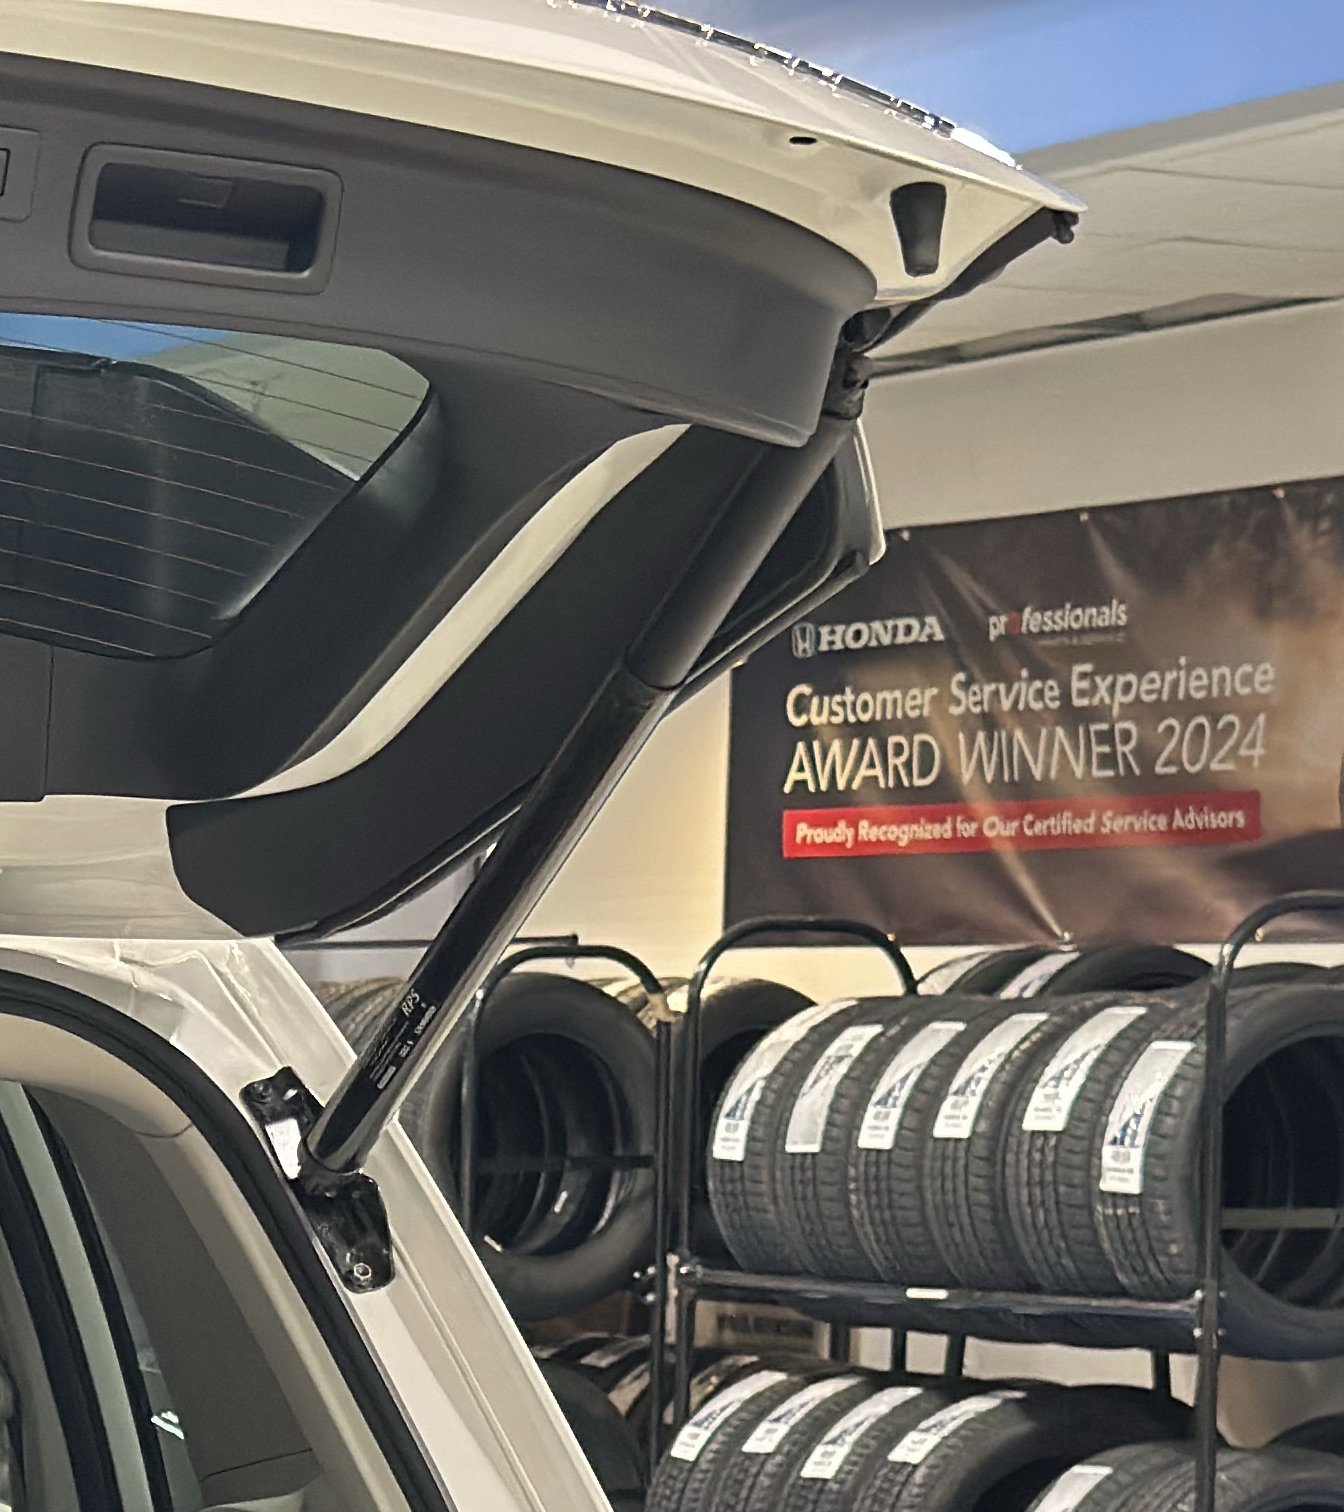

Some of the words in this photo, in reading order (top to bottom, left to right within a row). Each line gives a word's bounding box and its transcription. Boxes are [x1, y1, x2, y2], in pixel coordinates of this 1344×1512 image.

[818, 615, 946, 652] HONDA
[988, 598, 1128, 643] professionals
[786, 682, 939, 728] Customer
[948, 667, 1061, 717] Service
[1071, 655, 1275, 719] Experience
[783, 733, 941, 794] AWARD
[958, 720, 1141, 786] WINNER
[1154, 712, 1267, 775] 2024
[795, 819, 855, 849] Proudly
[857, 817, 953, 848] Recognized
[956, 815, 978, 838] for
[983, 815, 1018, 838] Our
[1022, 809, 1096, 836] Certified
[1100, 809, 1169, 834] Service
[1172, 804, 1246, 831] Advisors
